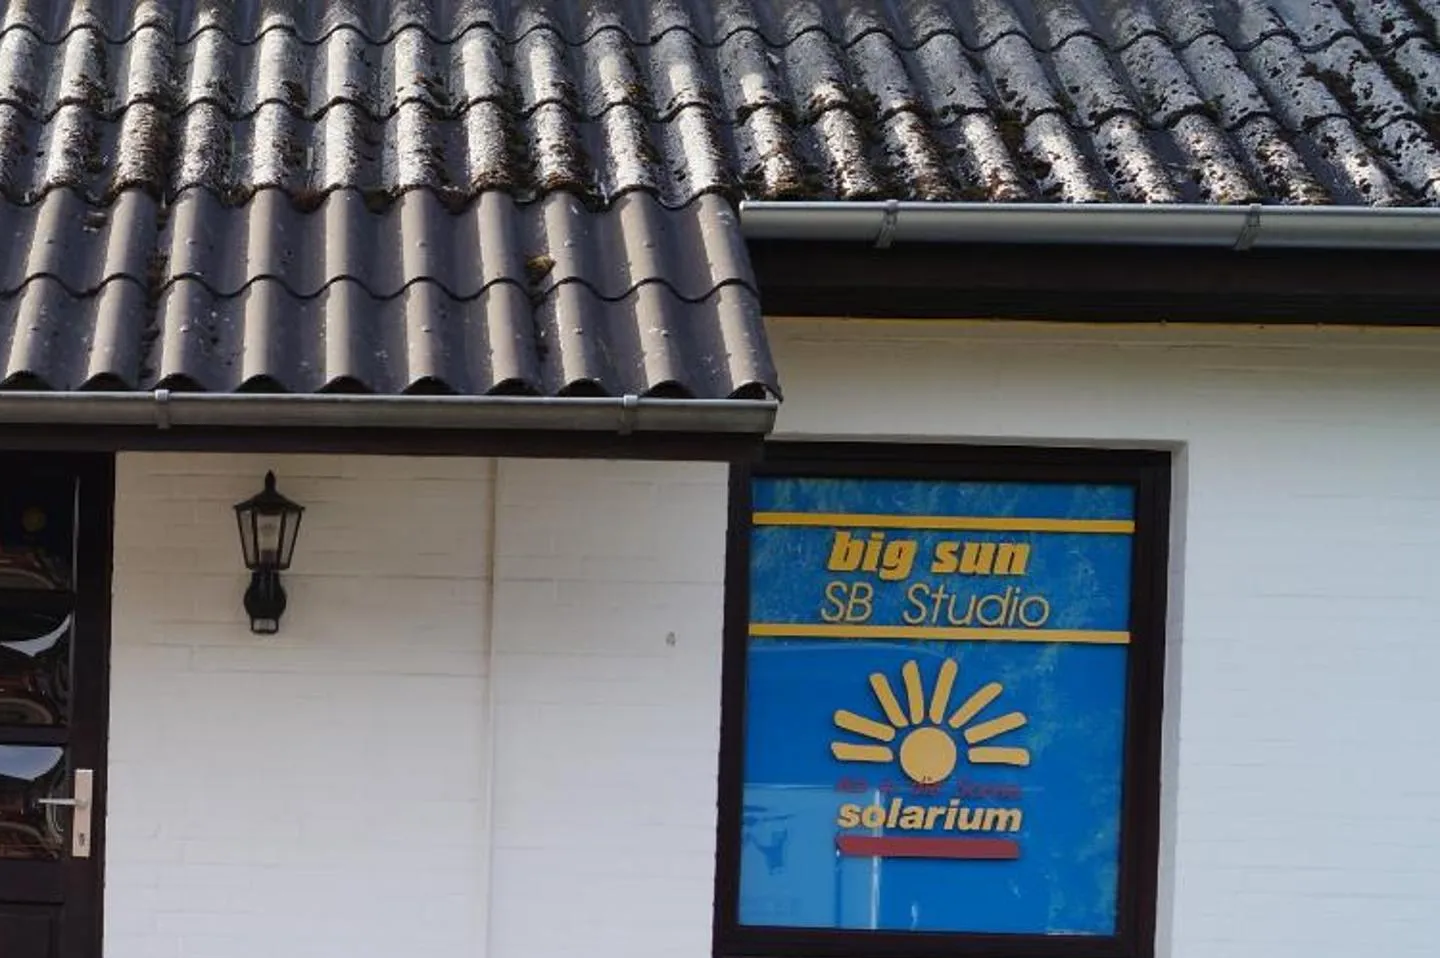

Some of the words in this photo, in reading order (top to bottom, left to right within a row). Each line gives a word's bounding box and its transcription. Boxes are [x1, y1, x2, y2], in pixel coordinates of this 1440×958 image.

[828, 531, 917, 581] big
[931, 541, 1030, 576] sun
[821, 581, 873, 623] SB
[903, 582, 1050, 627] Studio
[837, 798, 1022, 832] solarium
